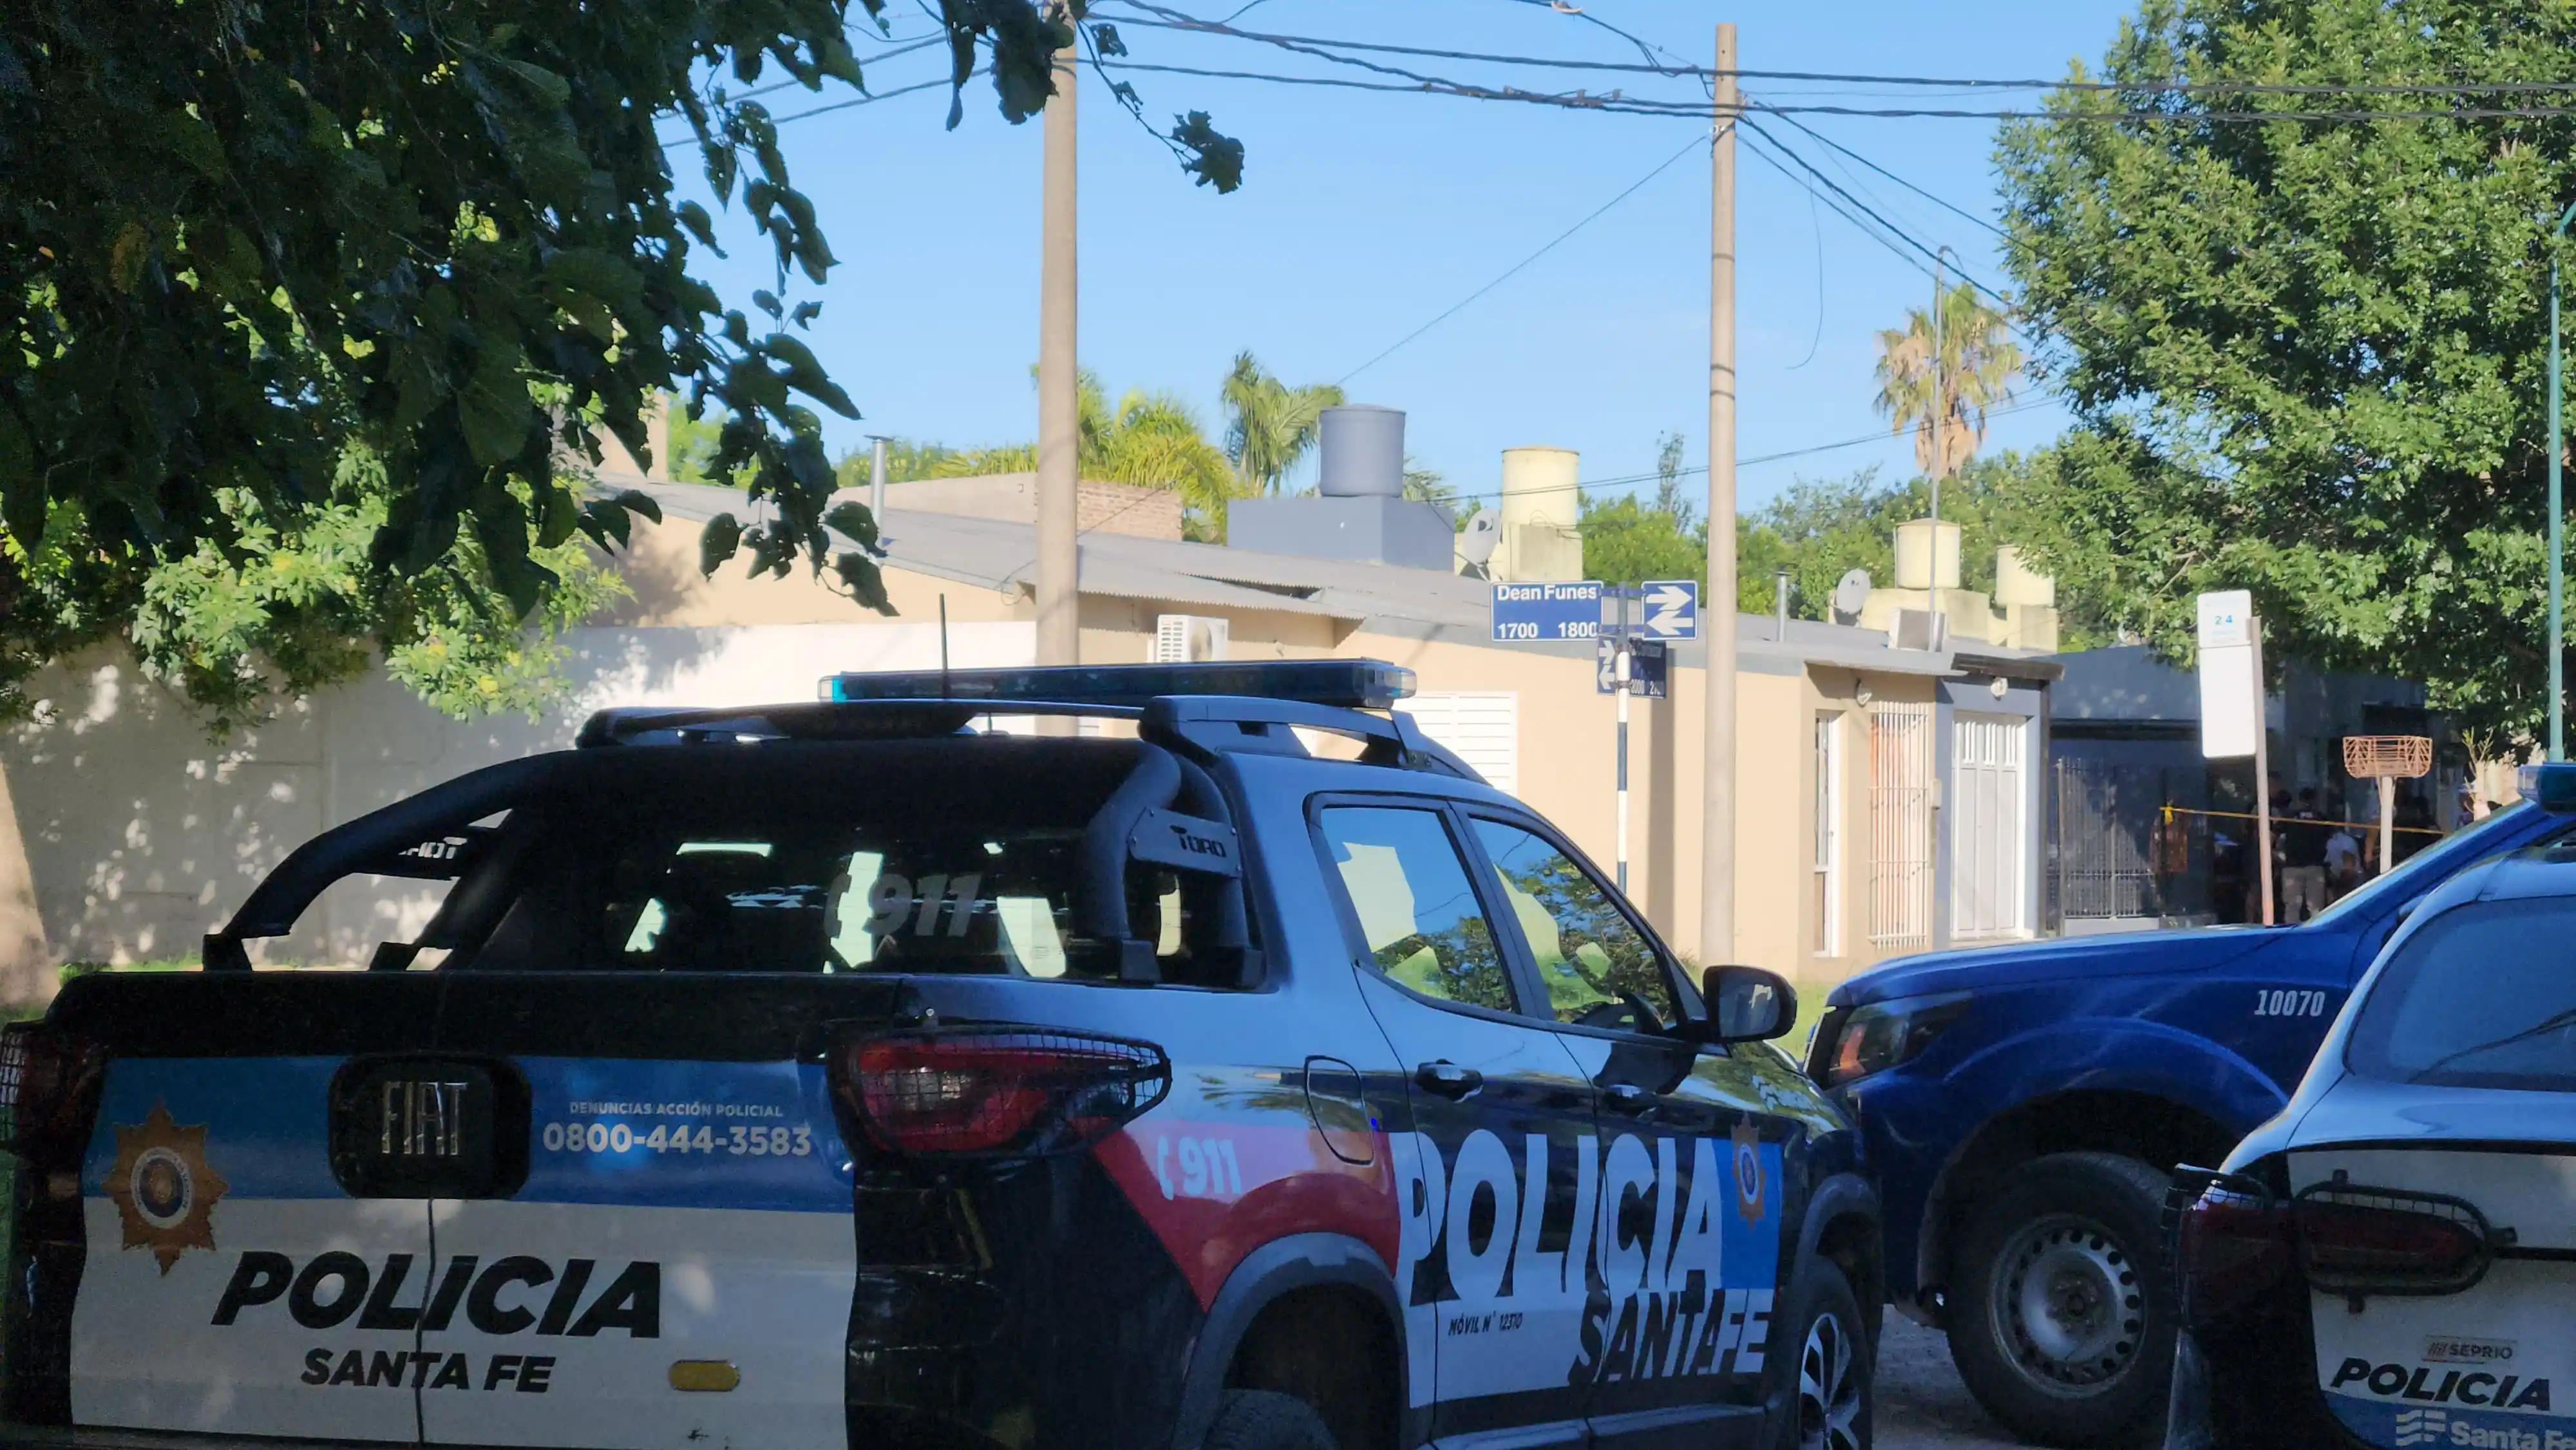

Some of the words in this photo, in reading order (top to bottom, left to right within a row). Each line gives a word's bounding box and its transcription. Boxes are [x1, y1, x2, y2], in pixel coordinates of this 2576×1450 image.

[1497, 585, 1541, 601] Dean
[1544, 585, 1597, 601] Funes
[1498, 622, 1539, 639] 1700
[1558, 621, 1597, 638] 1800
[1169, 824, 1227, 858] TORO
[862, 872, 981, 937] 911
[2255, 990, 2325, 1016] 10070
[381, 1081, 470, 1156] FIAT
[569, 1102, 652, 1115] DENUNCIAS
[656, 1101, 712, 1116] ACCIÓN
[716, 1104, 784, 1117] POLICIAL
[544, 1124, 811, 1156] 0800-444-3583
[1178, 1136, 1242, 1195] 911
[1389, 1128, 1722, 1307] POLICIA
[210, 1250, 661, 1339] POLICIA
[2449, 1342, 2513, 1360] SEPRIO
[301, 1348, 469, 1391] SANTA
[484, 1355, 556, 1393] FE
[2330, 1357, 2550, 1411] POLICIA
[2450, 1420, 2539, 1450] Santa
